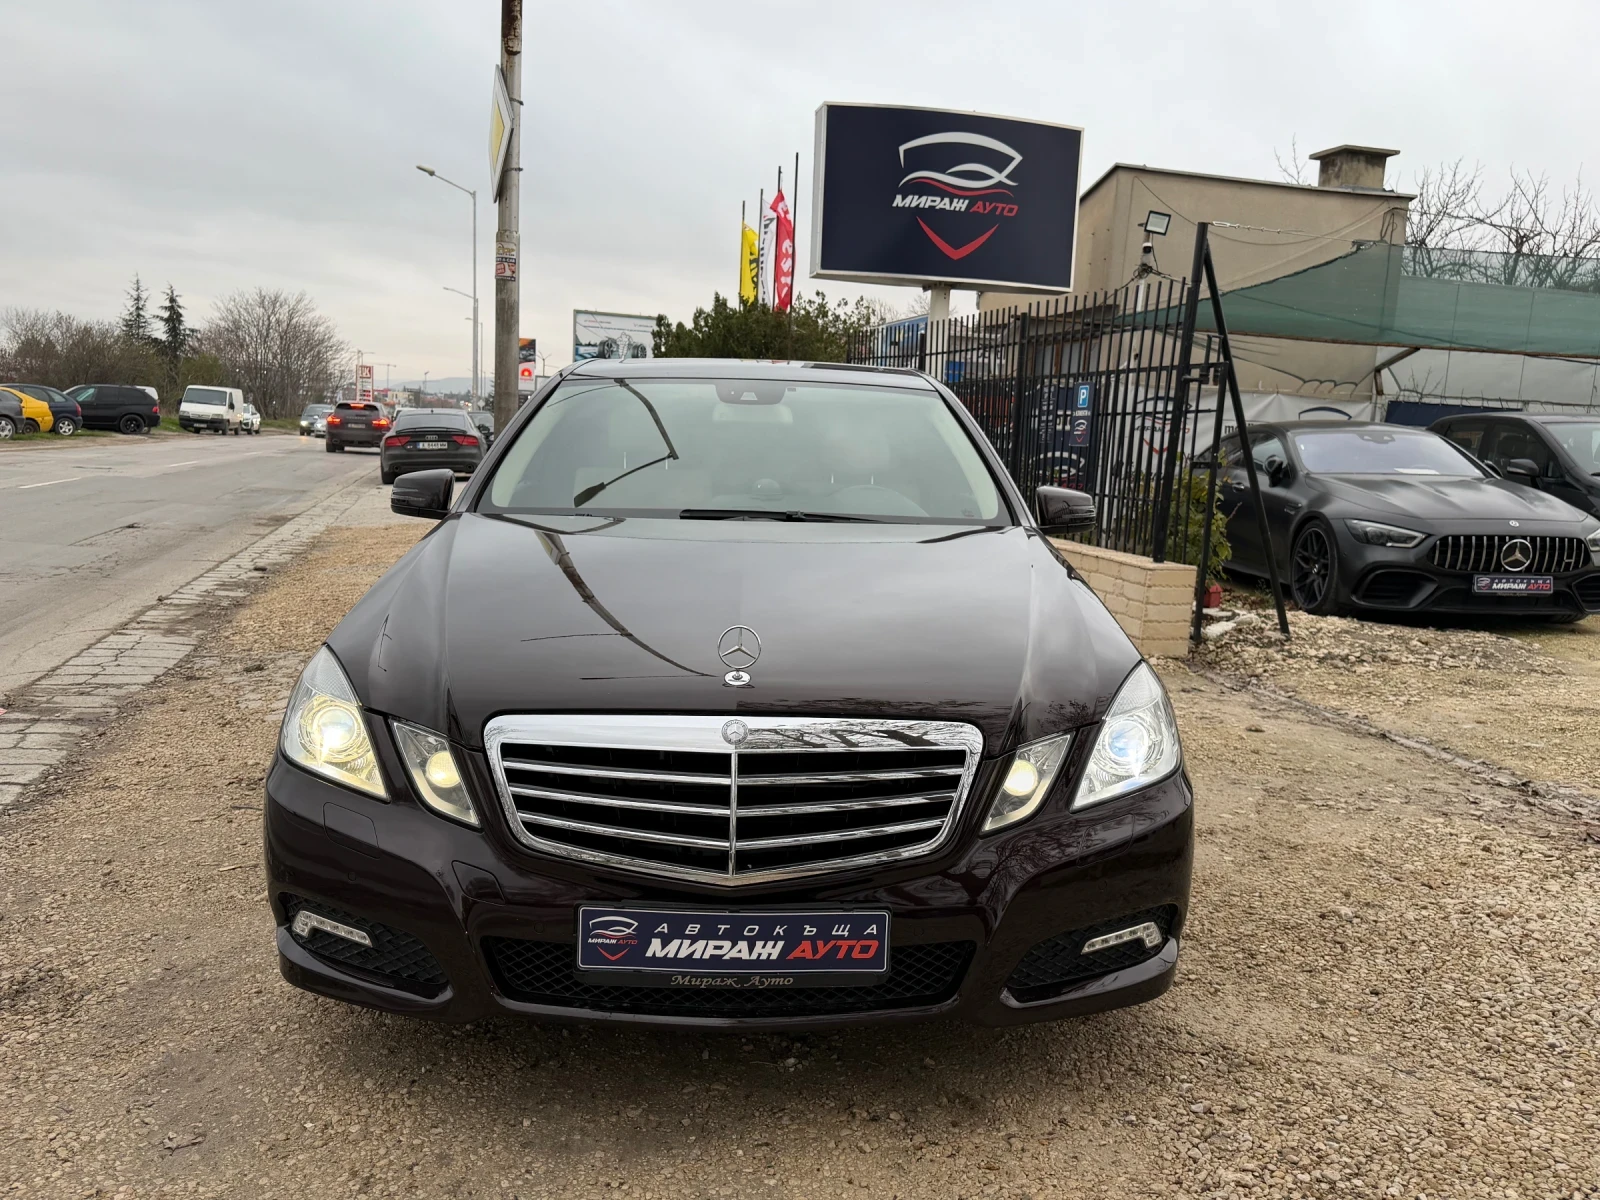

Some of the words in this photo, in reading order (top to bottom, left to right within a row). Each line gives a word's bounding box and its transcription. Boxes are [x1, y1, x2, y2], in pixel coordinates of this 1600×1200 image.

[892, 194, 969, 212] МИРАЖ
[970, 201, 1019, 217] АУТО
[654, 923, 878, 937] АВТОКЪЩА
[645, 938, 785, 960] МИРАЖ
[786, 940, 879, 960] АУТО
[670, 975, 741, 989] Мираж
[744, 976, 794, 988] Ауто
